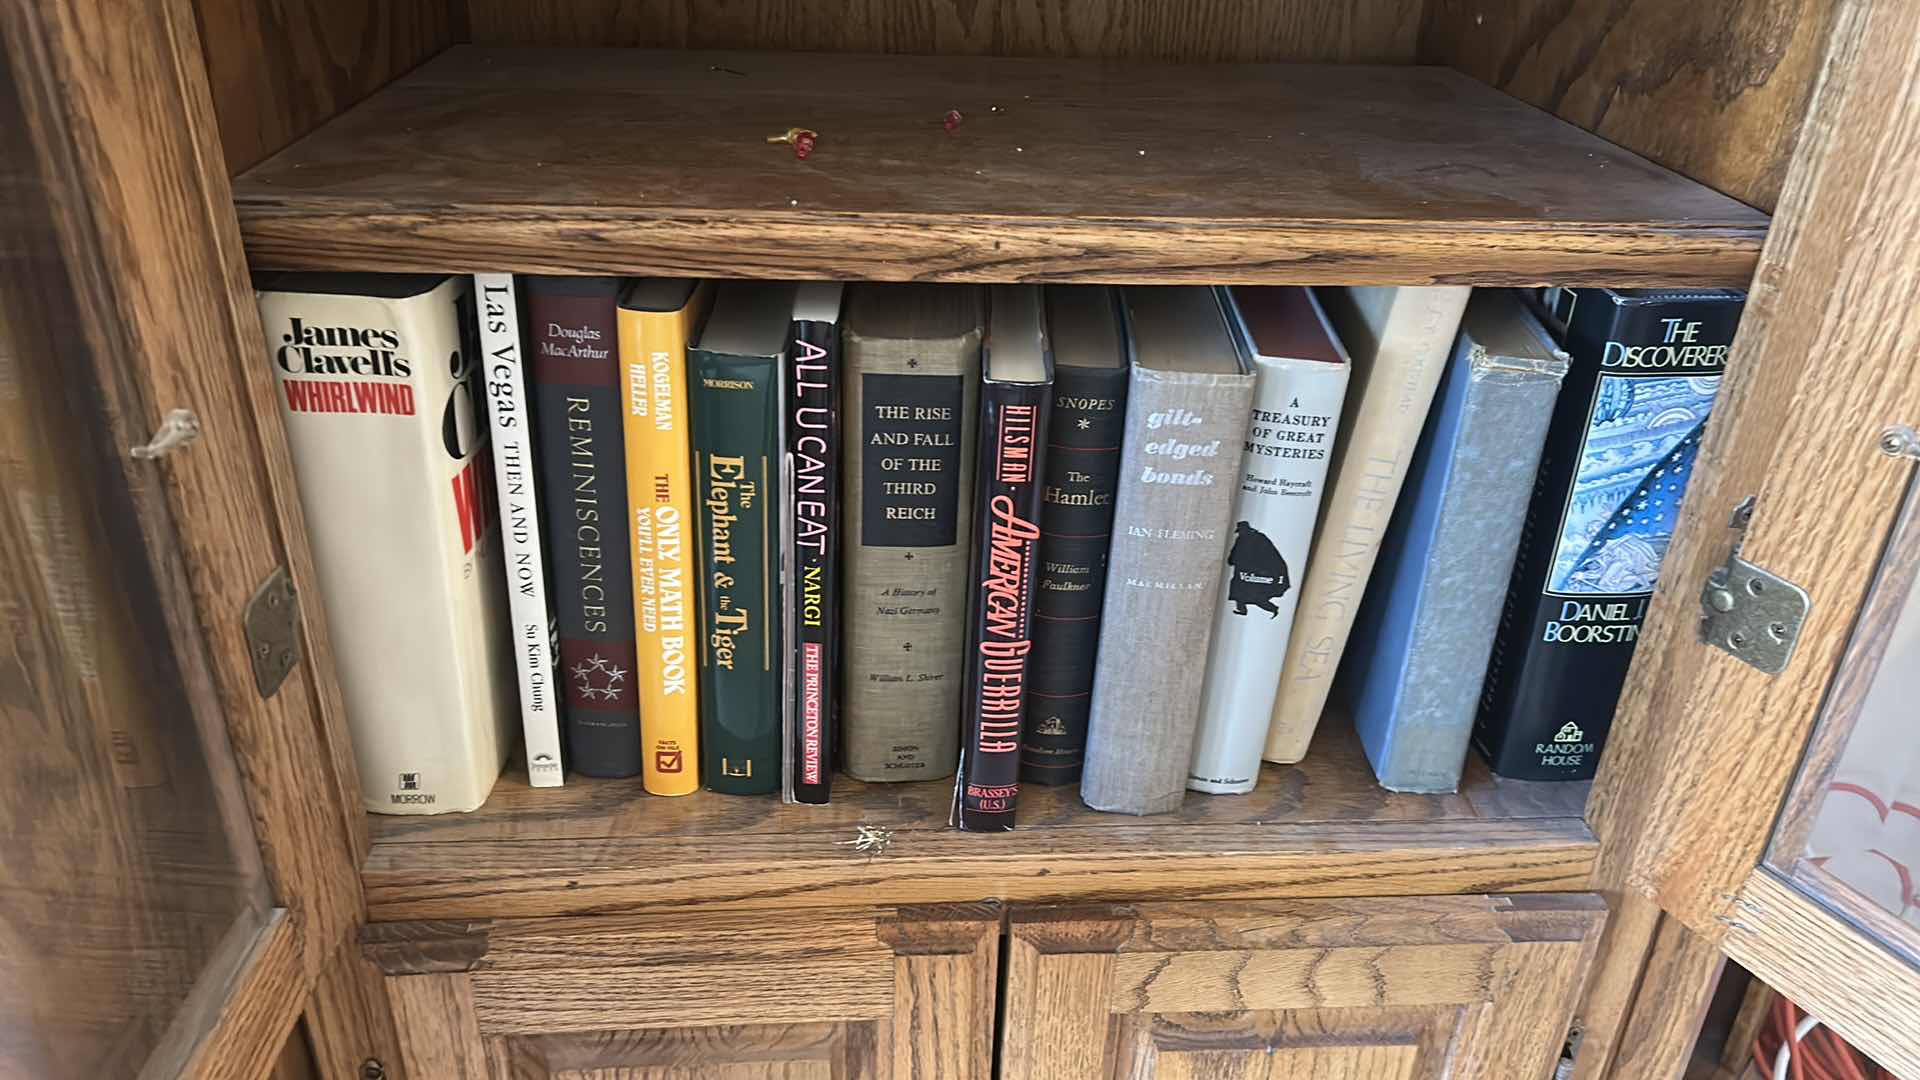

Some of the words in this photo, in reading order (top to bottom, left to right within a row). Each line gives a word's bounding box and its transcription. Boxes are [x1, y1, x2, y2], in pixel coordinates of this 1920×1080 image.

[484, 285, 508, 334] Las
[283, 317, 400, 349] James
[547, 322, 601, 345] Douglas
[1660, 318, 1703, 344] THE
[277, 345, 412, 378] Clavell's
[540, 341, 609, 361] MacArthur
[1601, 341, 1729, 367] DISCOVERER
[795, 339, 828, 397] ALL
[489, 343, 517, 428] Vegas
[629, 363, 648, 416] HELLER
[651, 352, 673, 431] KOGELMAN
[703, 378, 754, 390] MORRISON
[283, 379, 416, 416] WHIRLWIND
[1056, 396, 1116, 411] SNOPES
[1289, 397, 1300, 409] A
[875, 405, 910, 421] THE
[914, 406, 952, 421] RISE
[1147, 408, 1203, 430] gilt-
[1252, 408, 1332, 428] TREASURY
[870, 432, 909, 447] AND
[914, 433, 954, 447] FALL
[1001, 405, 1032, 483] HILSMAN
[1252, 427, 1272, 439] OF
[1276, 429, 1325, 444] GREAT
[1143, 438, 1221, 460] edged
[1243, 441, 1325, 460] MYSTERIES
[504, 441, 524, 496] THEN
[880, 457, 904, 471] OF
[908, 459, 942, 472] THE
[1067, 471, 1092, 482] The
[1140, 466, 1215, 486] bonds
[655, 474, 670, 502] THE
[740, 481, 756, 508] The
[882, 481, 938, 496] THIRD
[1045, 487, 1111, 506] Hamlet
[566, 397, 607, 634] REMINISCENCES
[706, 453, 745, 564] Elephant
[885, 507, 937, 521] REICH
[510, 503, 529, 544] AND
[636, 507, 653, 554] YOU'LL
[656, 506, 681, 561] ONLY
[1127, 525, 1153, 538] IAN
[1156, 528, 1217, 540] FLEMING
[516, 553, 536, 597] NOW
[641, 557, 656, 595] EVER
[982, 494, 1041, 638] AMERICAN
[1045, 562, 1091, 575] William
[1240, 571, 1274, 584] Volume
[713, 572, 735, 589] &
[1041, 578, 1092, 592] Faulkner
[658, 567, 683, 631] MATH
[803, 566, 822, 627] NARGI
[642, 597, 657, 633] NEED
[1560, 600, 1630, 622] DANIEL
[525, 624, 538, 639] Su
[711, 608, 748, 671] Tiger
[528, 642, 541, 669] Kim
[662, 635, 685, 695] BOOK
[805, 645, 819, 671] THE
[530, 672, 545, 712] Chung
[805, 672, 819, 737] PRINCETON
[977, 640, 1032, 753] GUERRILLA
[805, 738, 818, 784] REVIEW
[1535, 743, 1595, 754] RANDOM
[1541, 755, 1584, 766] HOUSE
[391, 794, 436, 804] MORROW
